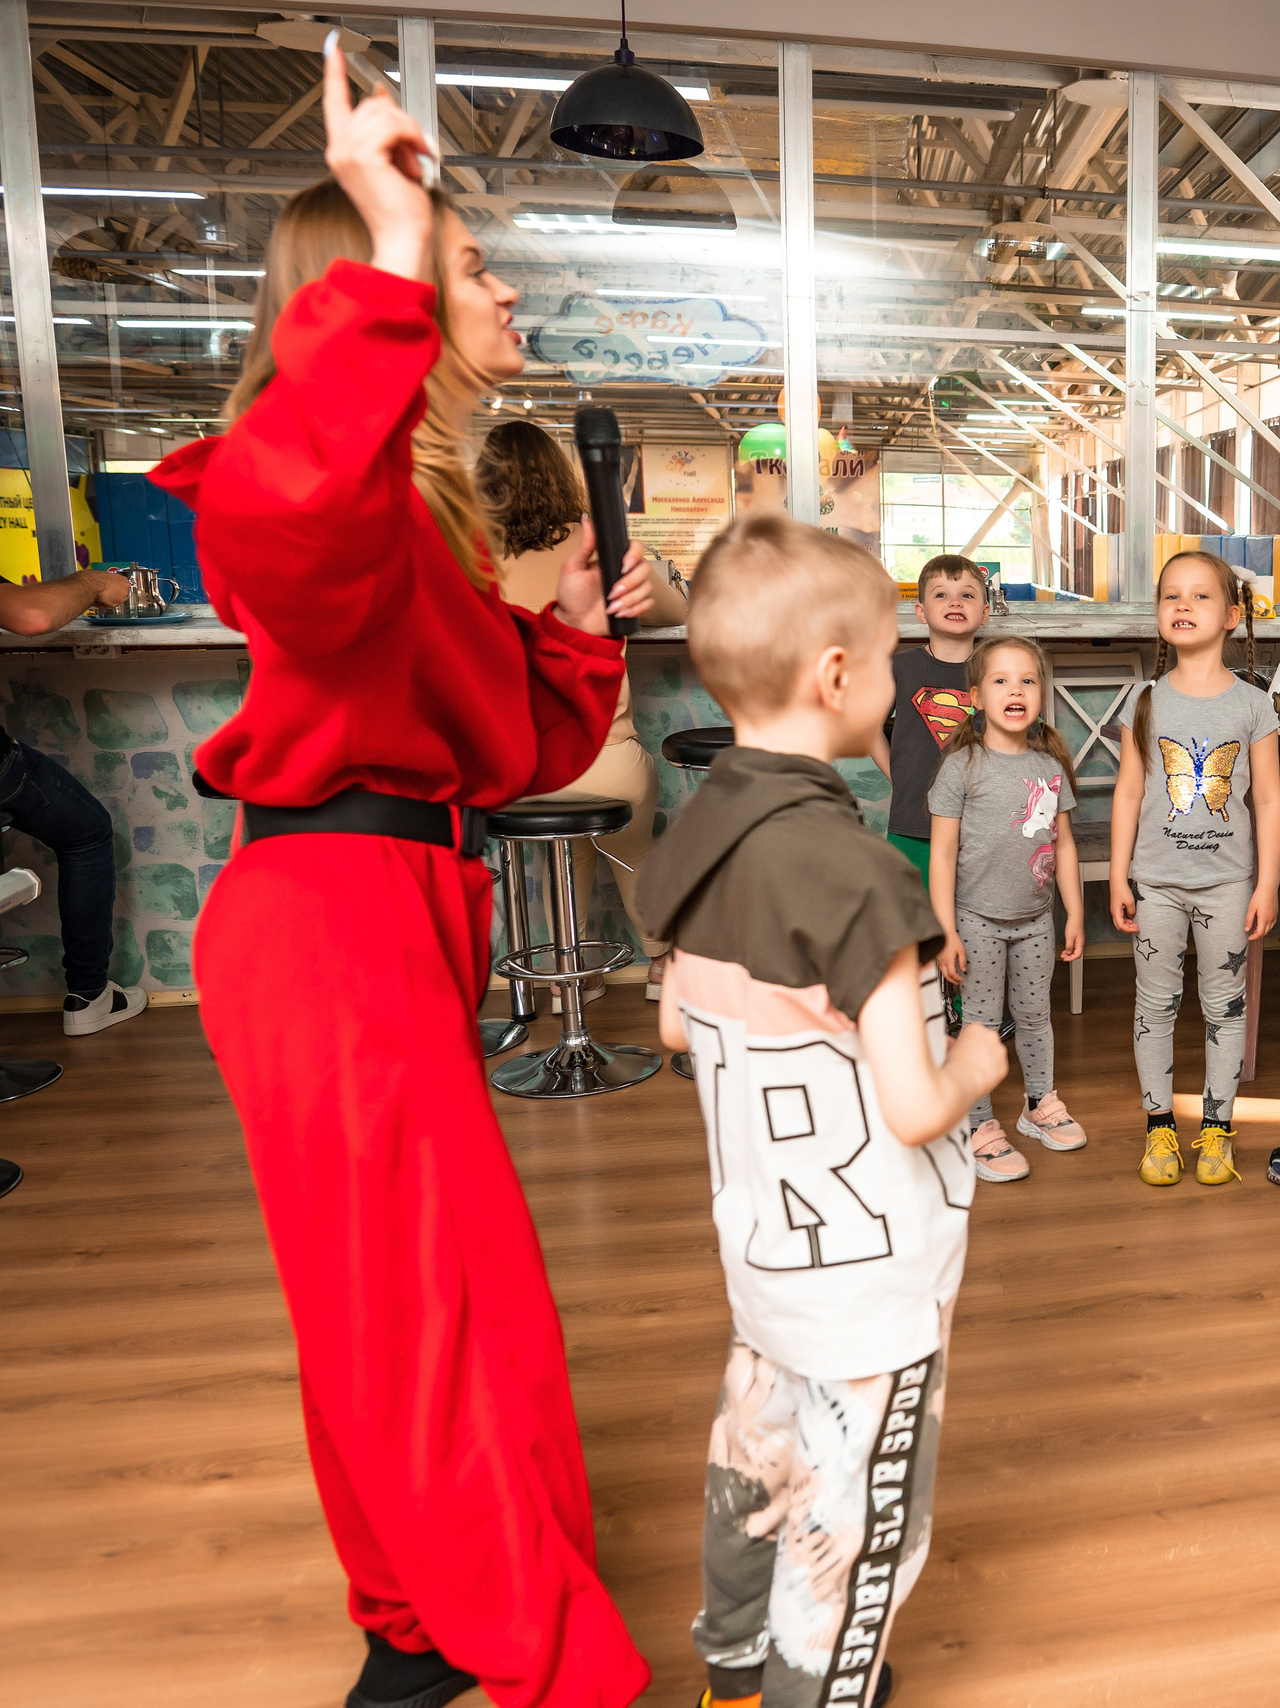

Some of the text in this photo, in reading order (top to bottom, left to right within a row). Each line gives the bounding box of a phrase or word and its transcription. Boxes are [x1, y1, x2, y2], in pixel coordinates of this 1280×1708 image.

[1163, 827, 1235, 840] Naturel Desin
[1175, 840, 1221, 853] Desing
[838, 1561, 891, 1673] SPORT
